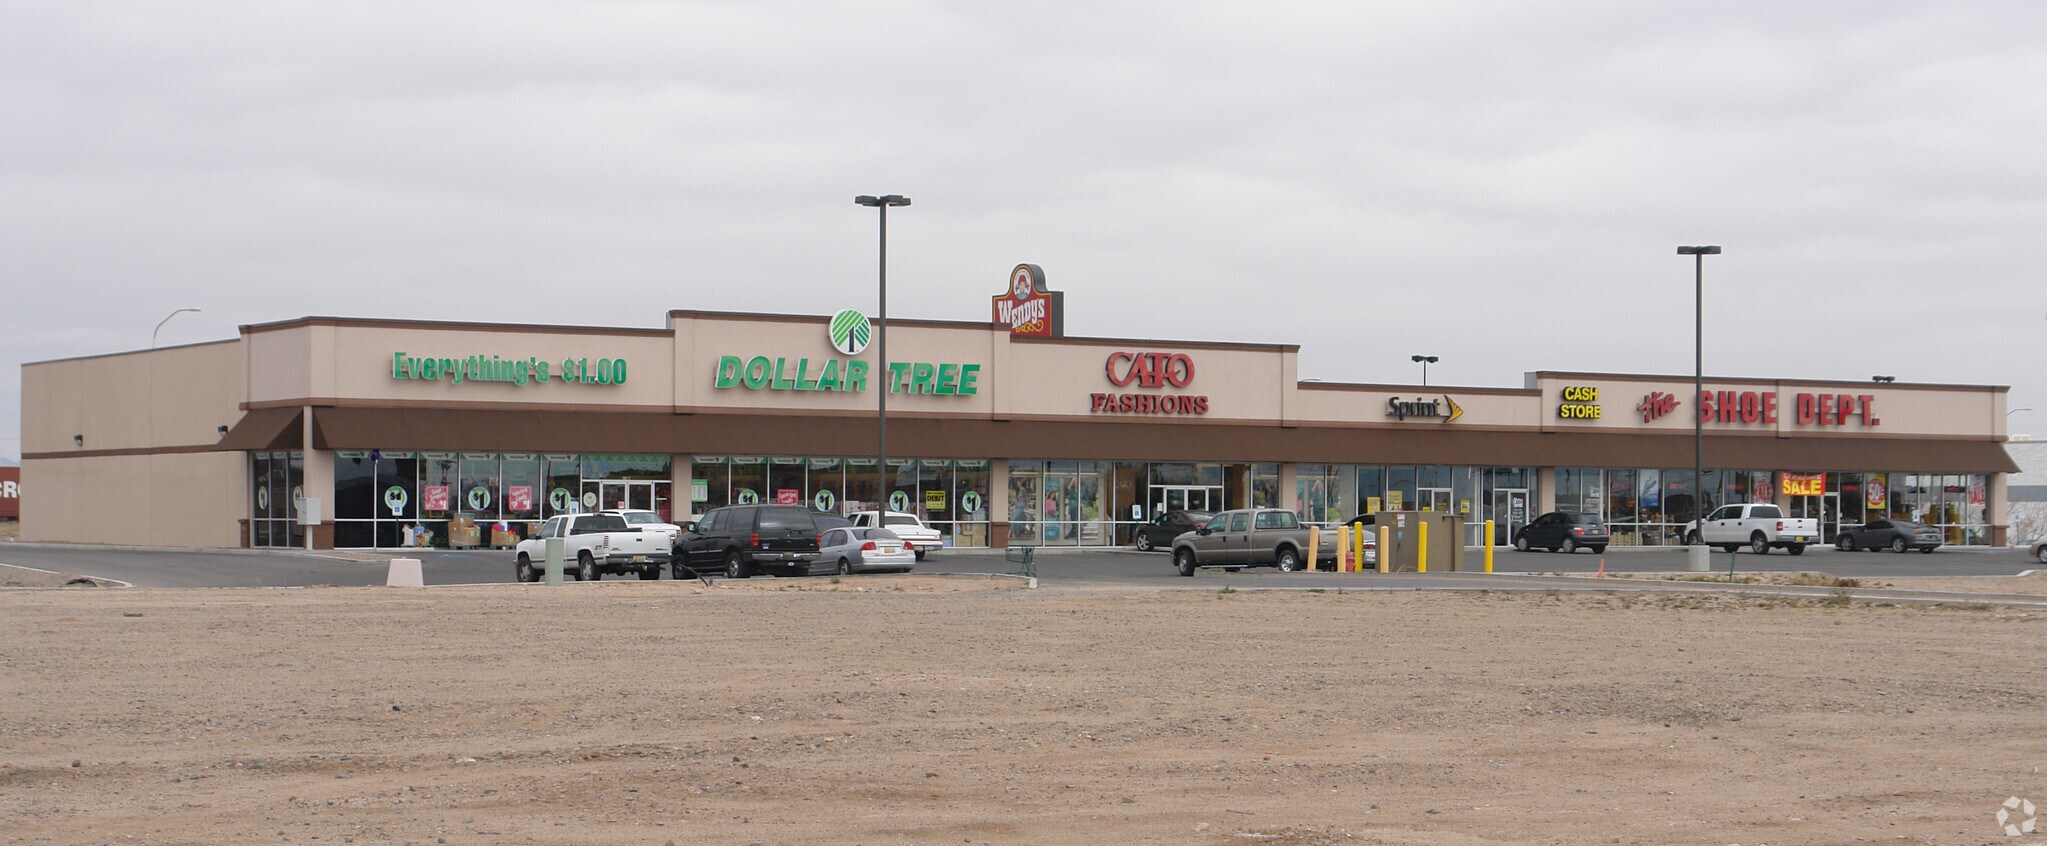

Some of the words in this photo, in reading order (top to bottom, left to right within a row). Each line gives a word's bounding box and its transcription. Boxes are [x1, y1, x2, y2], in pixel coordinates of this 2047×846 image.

[392, 352, 550, 386] Everything's
[561, 357, 628, 386] $1.00
[716, 356, 869, 392] DOLLAR
[887, 361, 982, 396] TREE
[1105, 351, 1196, 389] CATO
[1562, 386, 1599, 402] CASH
[1090, 392, 1209, 415] FASHIONS
[1388, 397, 1440, 421] Sprint
[1558, 403, 1601, 420] STORE
[1638, 391, 1681, 424] the
[1699, 390, 1777, 424] SHOE
[1796, 392, 1881, 427] DEPT.
[1782, 479, 1822, 495] SALE
[473, 491, 485, 509] $1
[819, 495, 830, 511] $1
[893, 496, 904, 511] $1
[966, 496, 976, 512] $1
